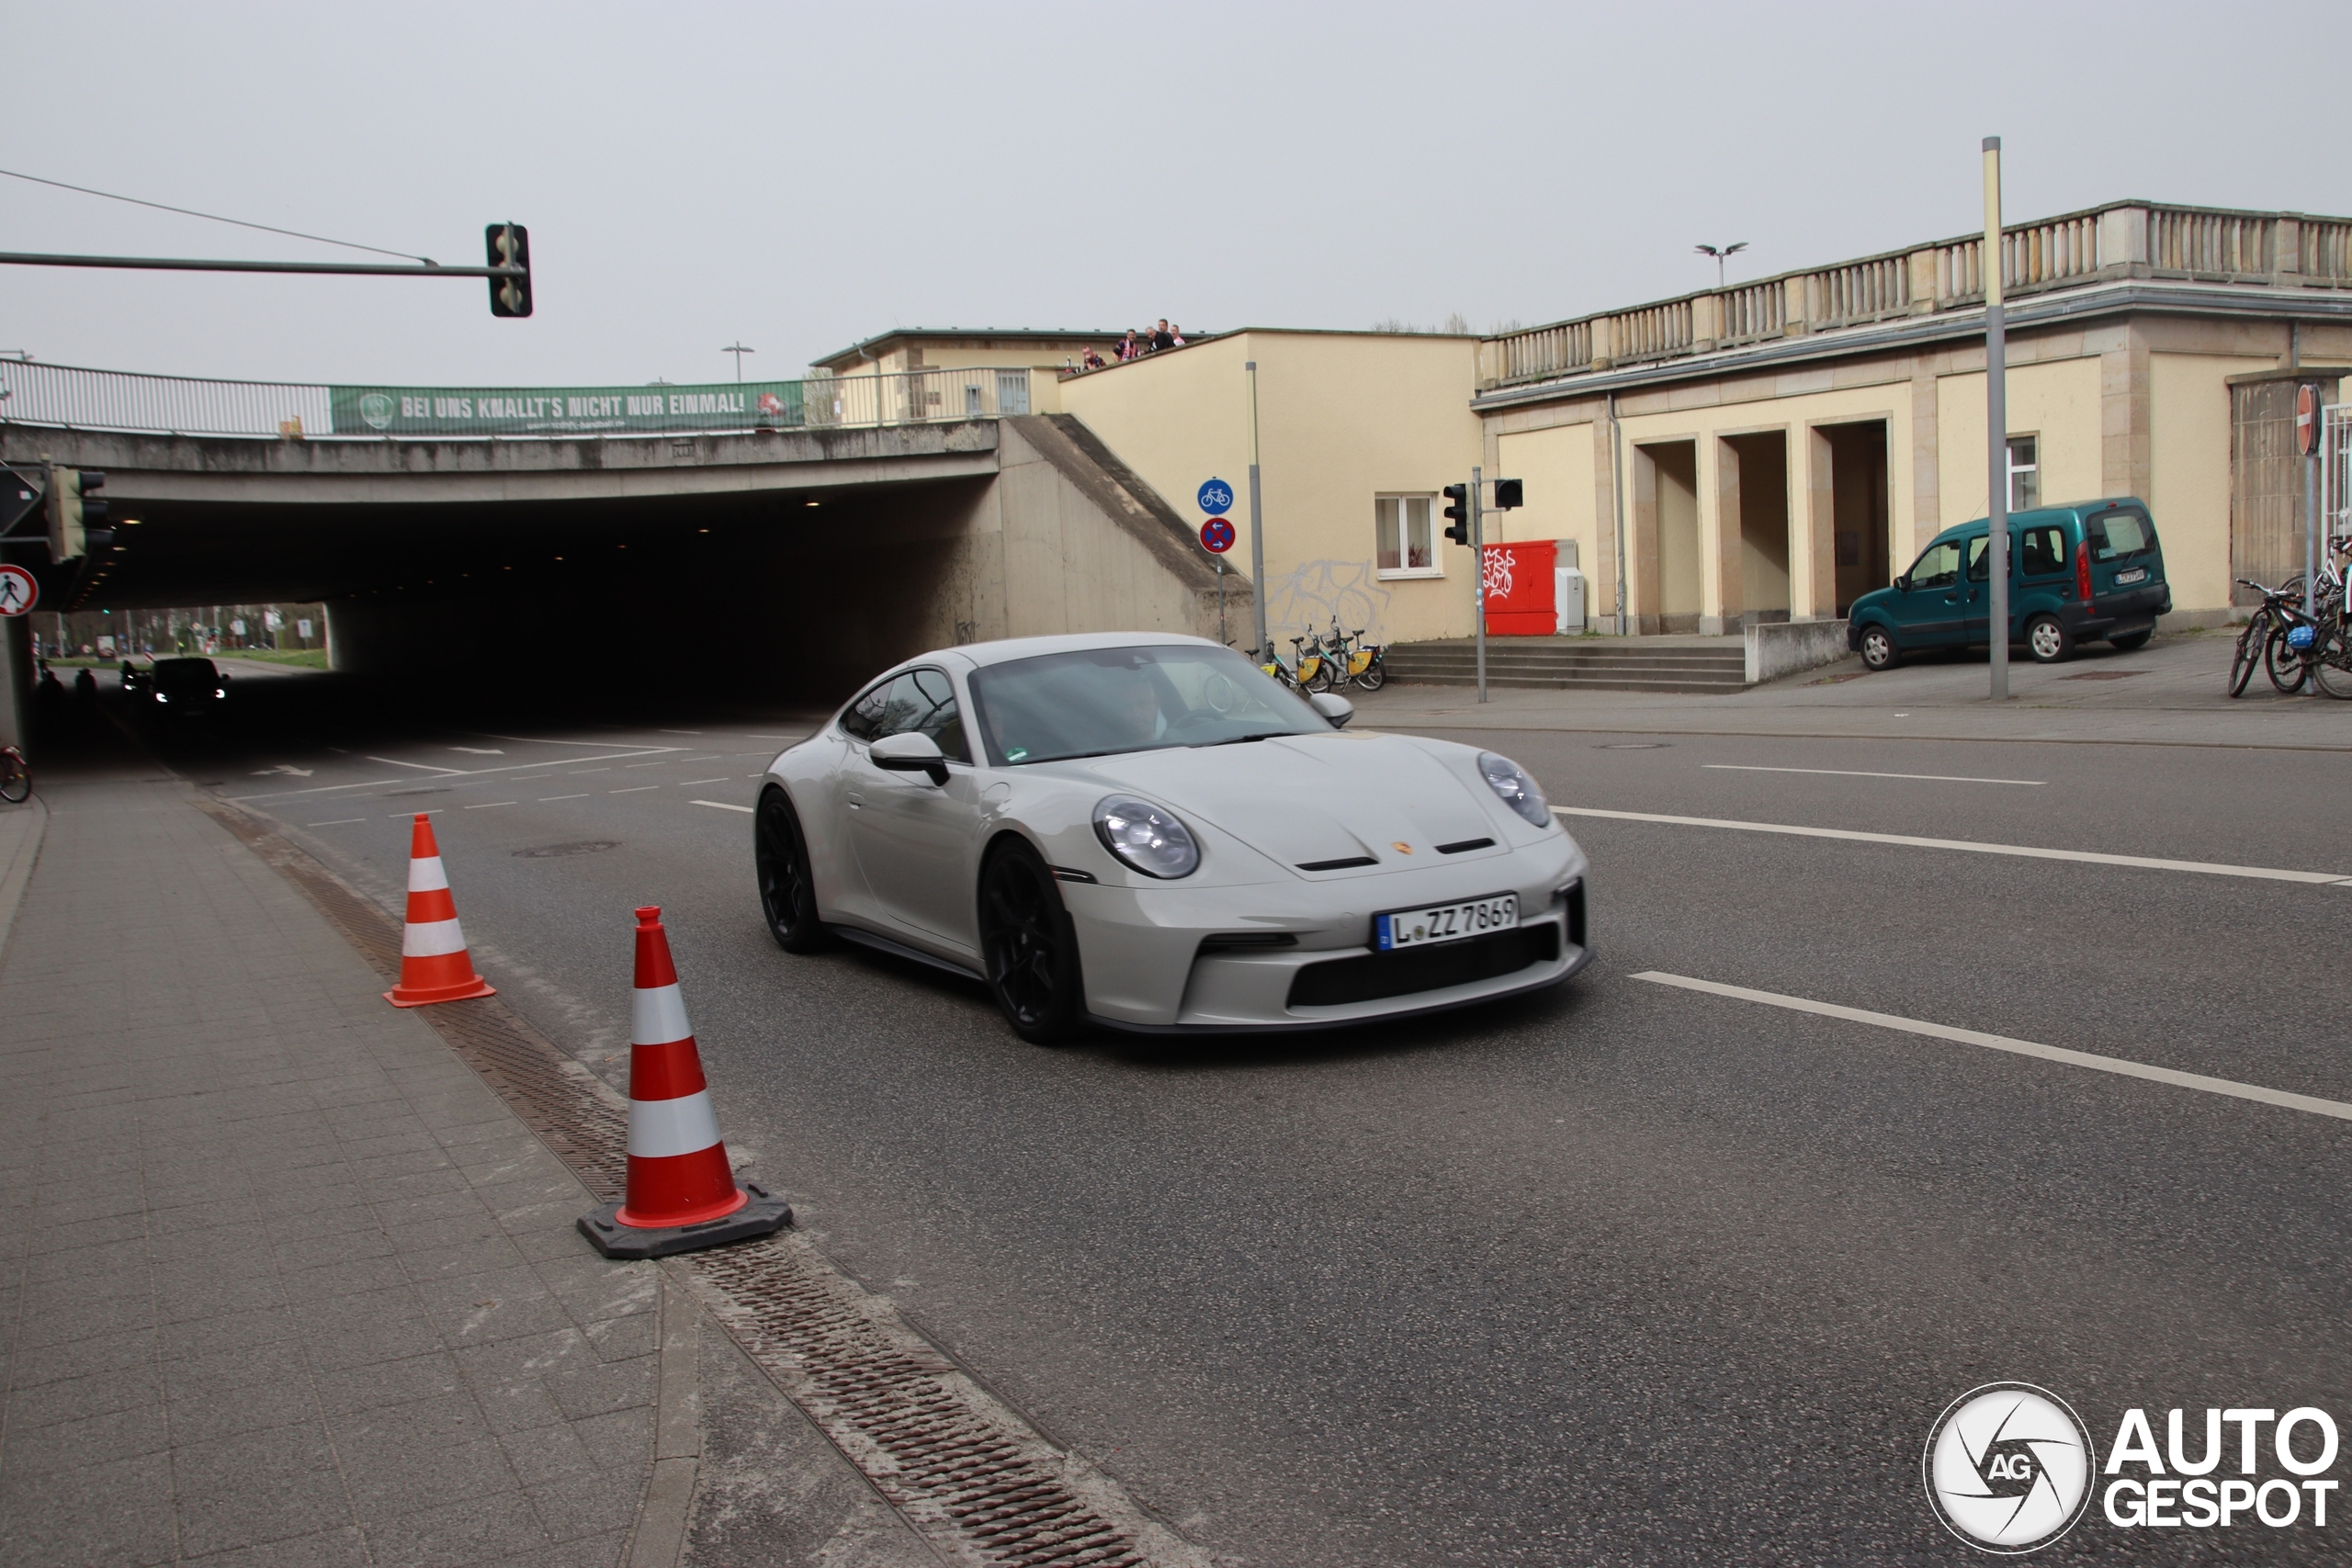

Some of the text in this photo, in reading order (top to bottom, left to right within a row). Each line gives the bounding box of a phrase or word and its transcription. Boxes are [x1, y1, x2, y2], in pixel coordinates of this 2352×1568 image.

[401, 396, 431, 418] BEI
[435, 397, 472, 419] UNS
[567, 395, 622, 417] NICHT
[627, 394, 664, 416] NUR
[669, 392, 745, 414] EINMAL!
[1394, 898, 1516, 944] L ZZ 7869
